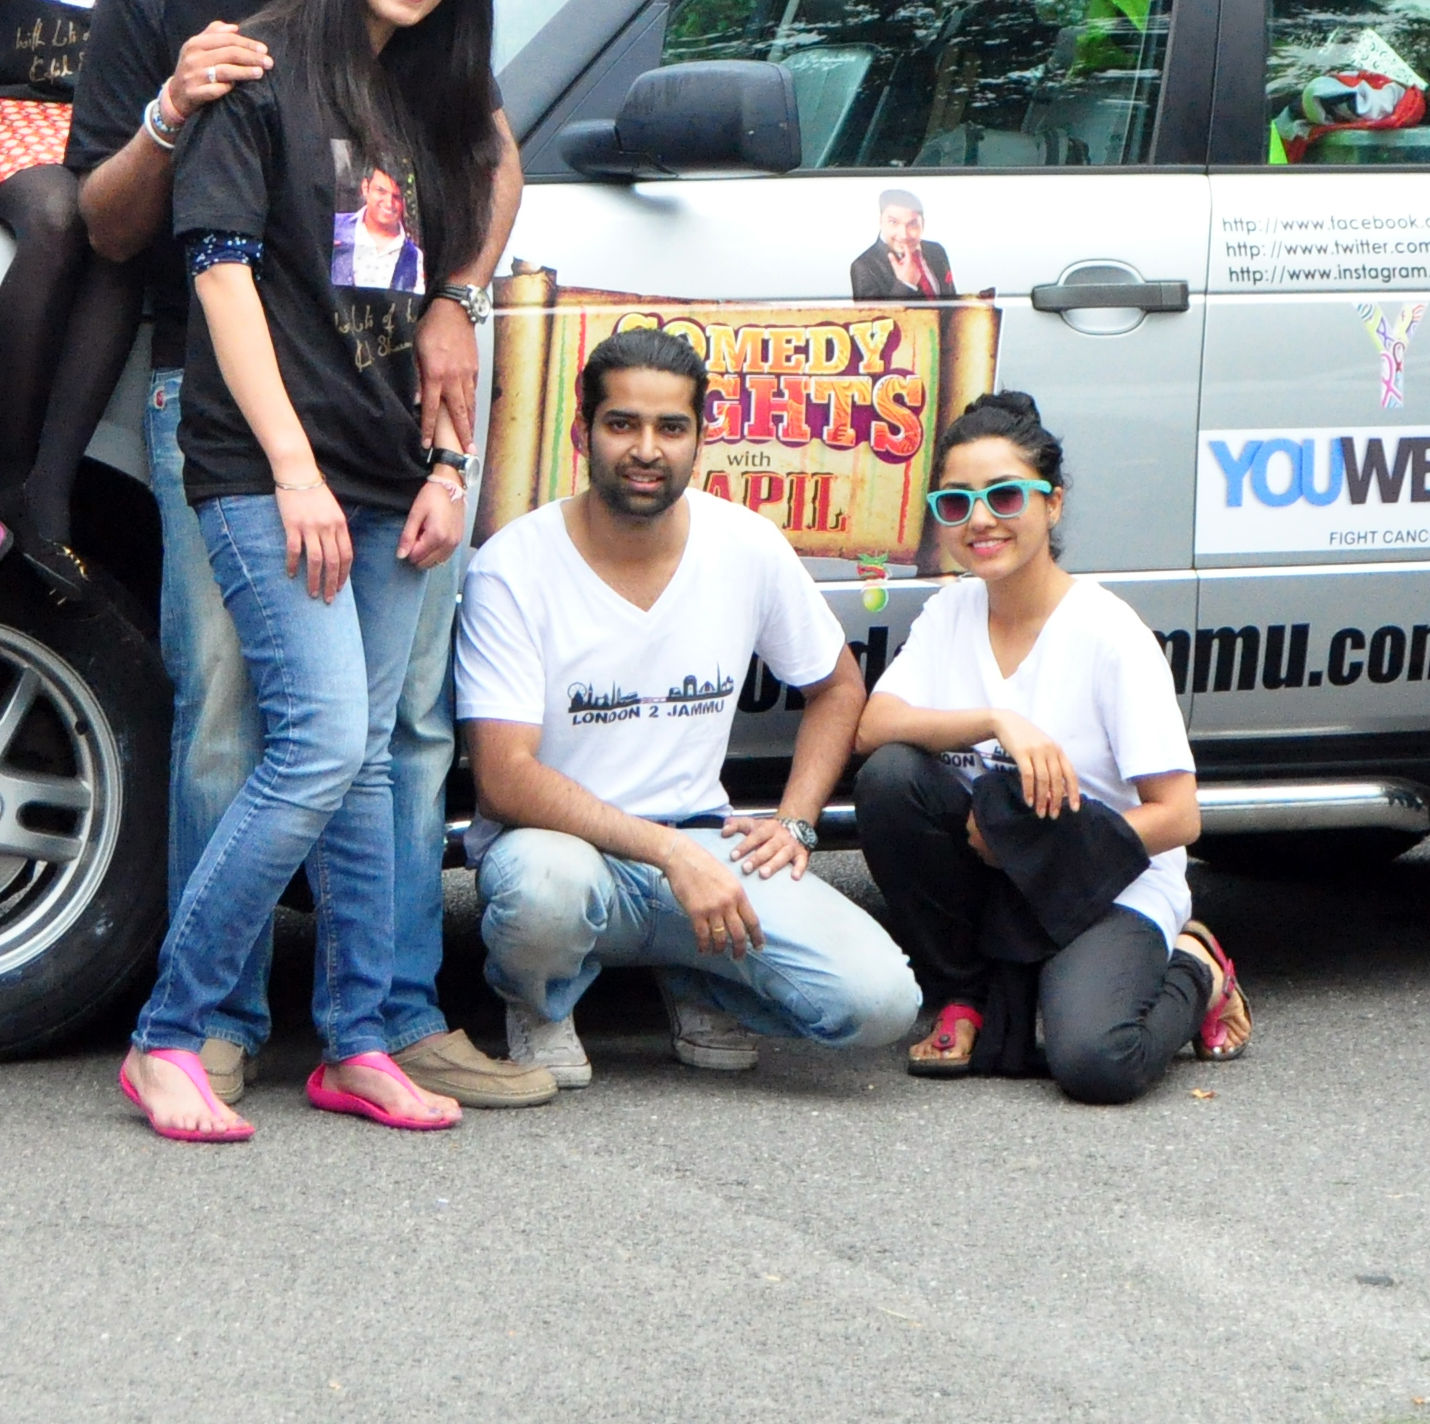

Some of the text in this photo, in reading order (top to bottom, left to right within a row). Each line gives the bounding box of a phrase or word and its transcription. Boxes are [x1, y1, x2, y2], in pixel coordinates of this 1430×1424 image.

[726, 451, 771, 468] with
[702, 470, 848, 533] APIL
[1329, 530, 1379, 546] FIGHT
[572, 698, 726, 726] LONDON 2 JAMMU
